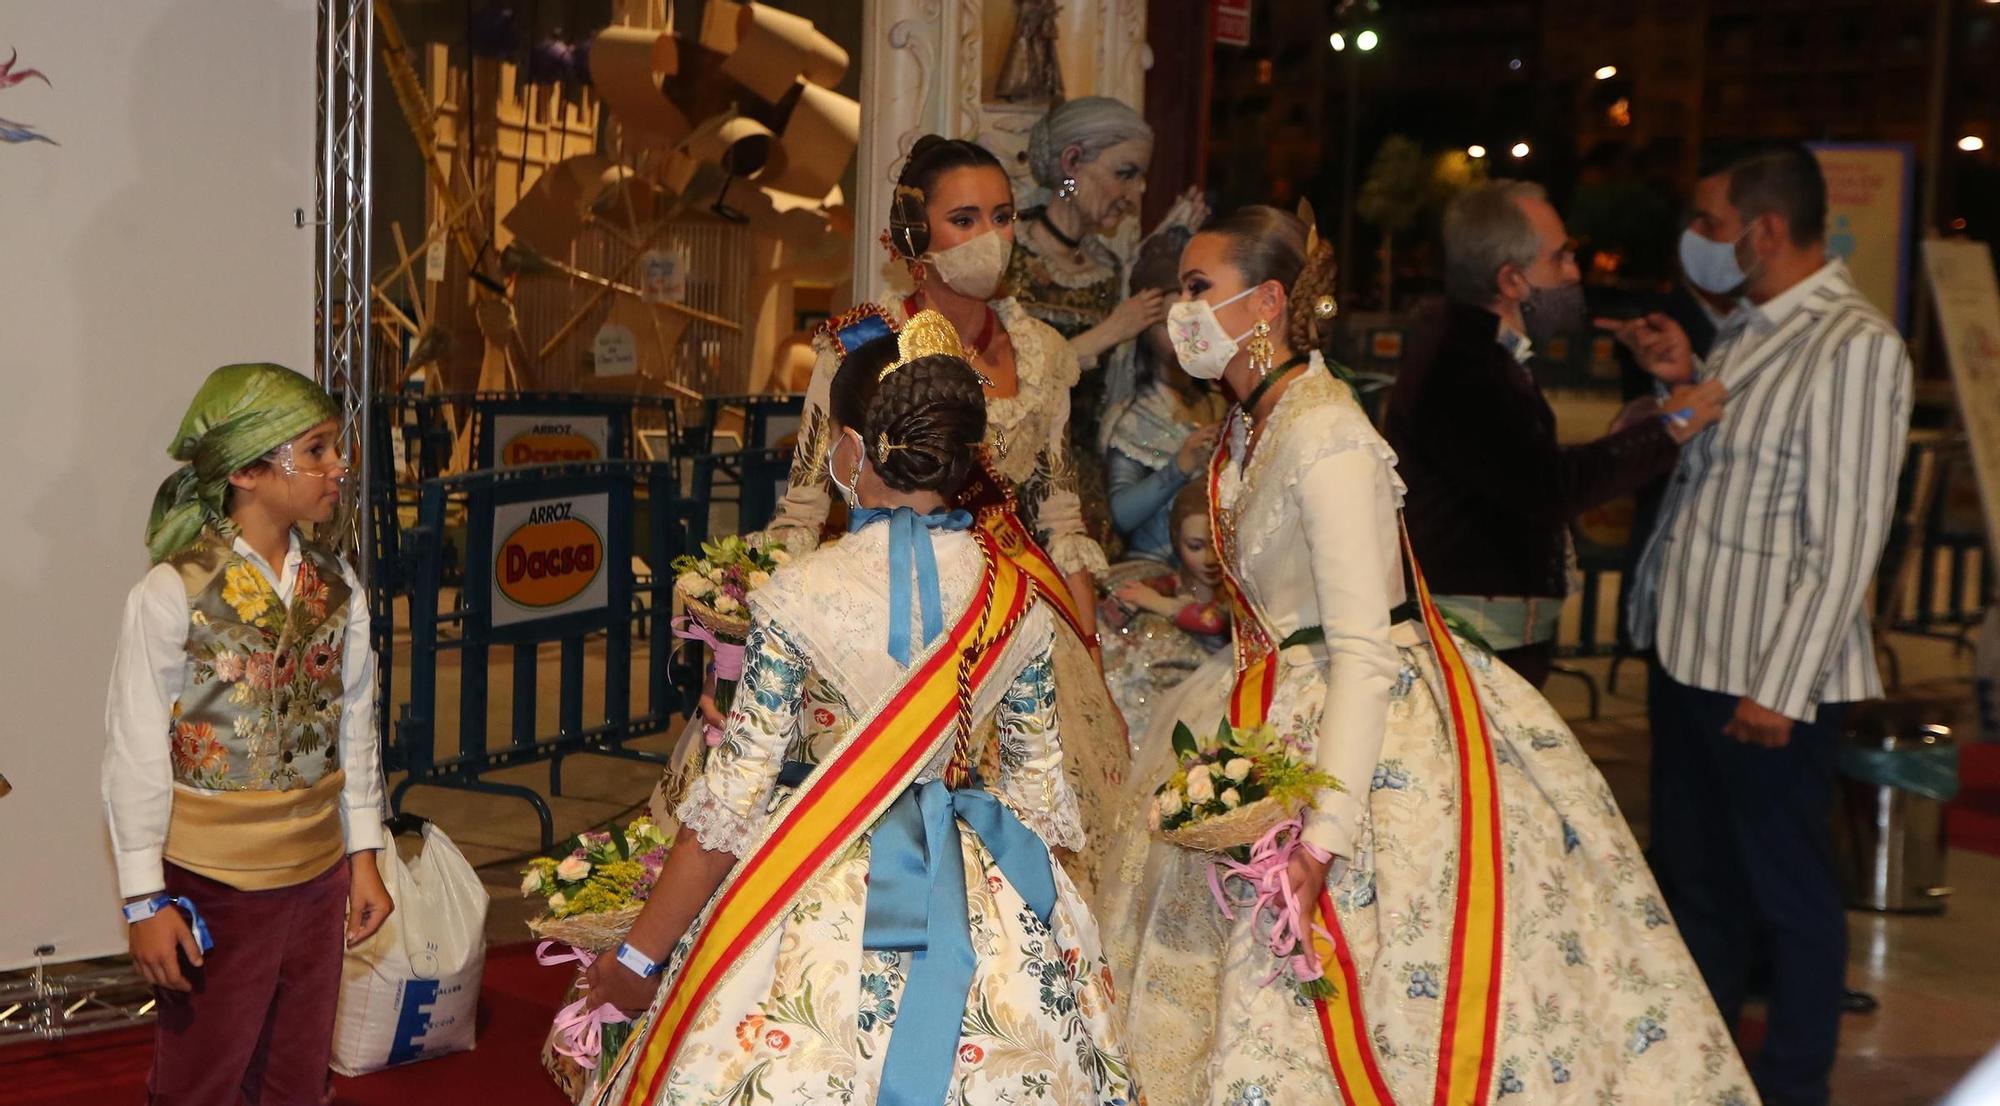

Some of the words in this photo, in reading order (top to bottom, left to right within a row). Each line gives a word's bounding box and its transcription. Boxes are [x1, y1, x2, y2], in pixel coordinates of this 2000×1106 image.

[533, 424, 572, 435] ARROZ
[528, 503, 572, 525] ARROZ
[506, 544, 595, 584] Dacsa
